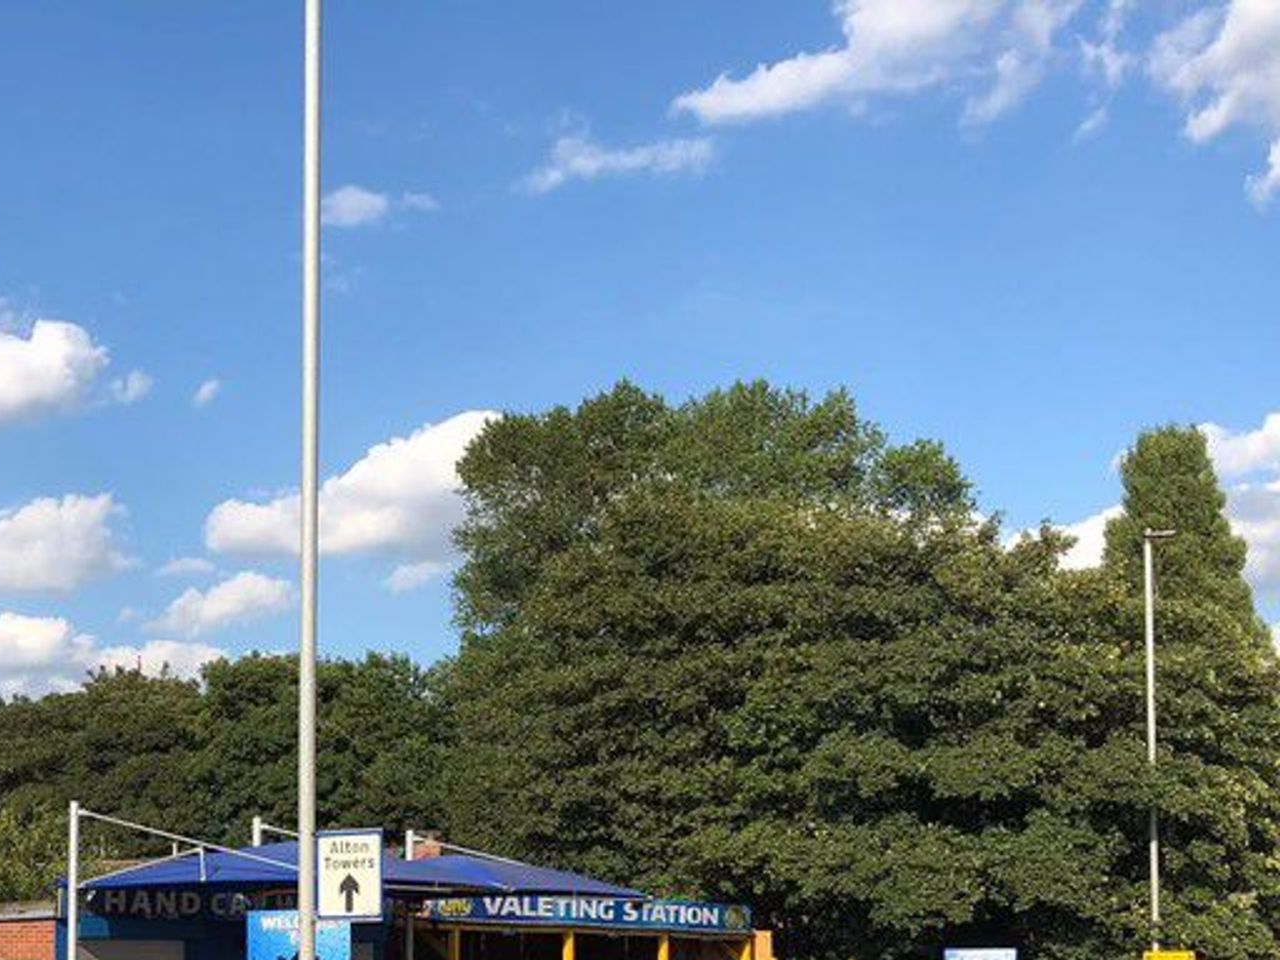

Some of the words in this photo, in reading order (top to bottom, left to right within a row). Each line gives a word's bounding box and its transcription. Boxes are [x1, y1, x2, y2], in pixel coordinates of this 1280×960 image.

[330, 841, 369, 853] Alton
[324, 857, 375, 869] Towers
[104, 890, 201, 914] HAND
[483, 897, 614, 920] VALETING
[623, 901, 718, 925] STATION
